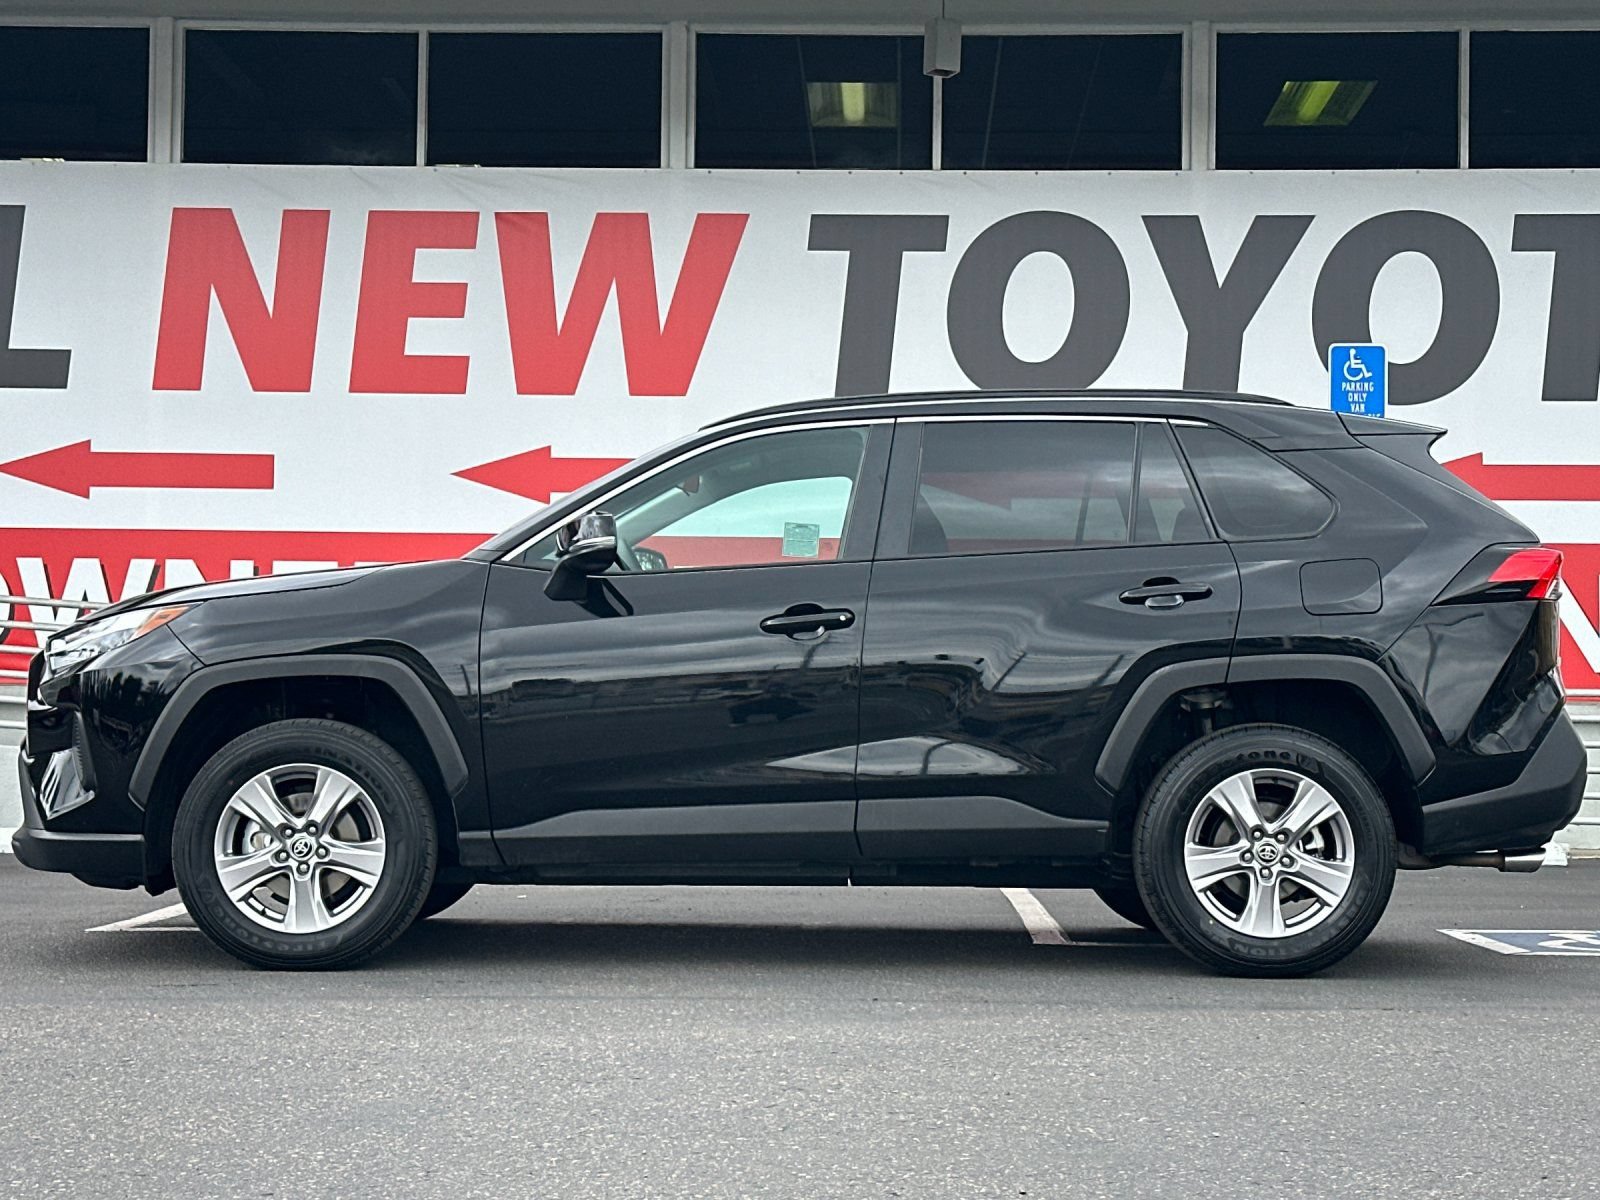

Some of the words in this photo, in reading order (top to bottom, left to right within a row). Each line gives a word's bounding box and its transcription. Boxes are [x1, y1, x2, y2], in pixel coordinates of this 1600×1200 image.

[152, 207, 750, 397] NEW
[807, 210, 1600, 406] TOYOT
[1341, 382, 1375, 392] PARKING
[1348, 392, 1368, 402] ONLY
[1350, 403, 1366, 413] VAN
